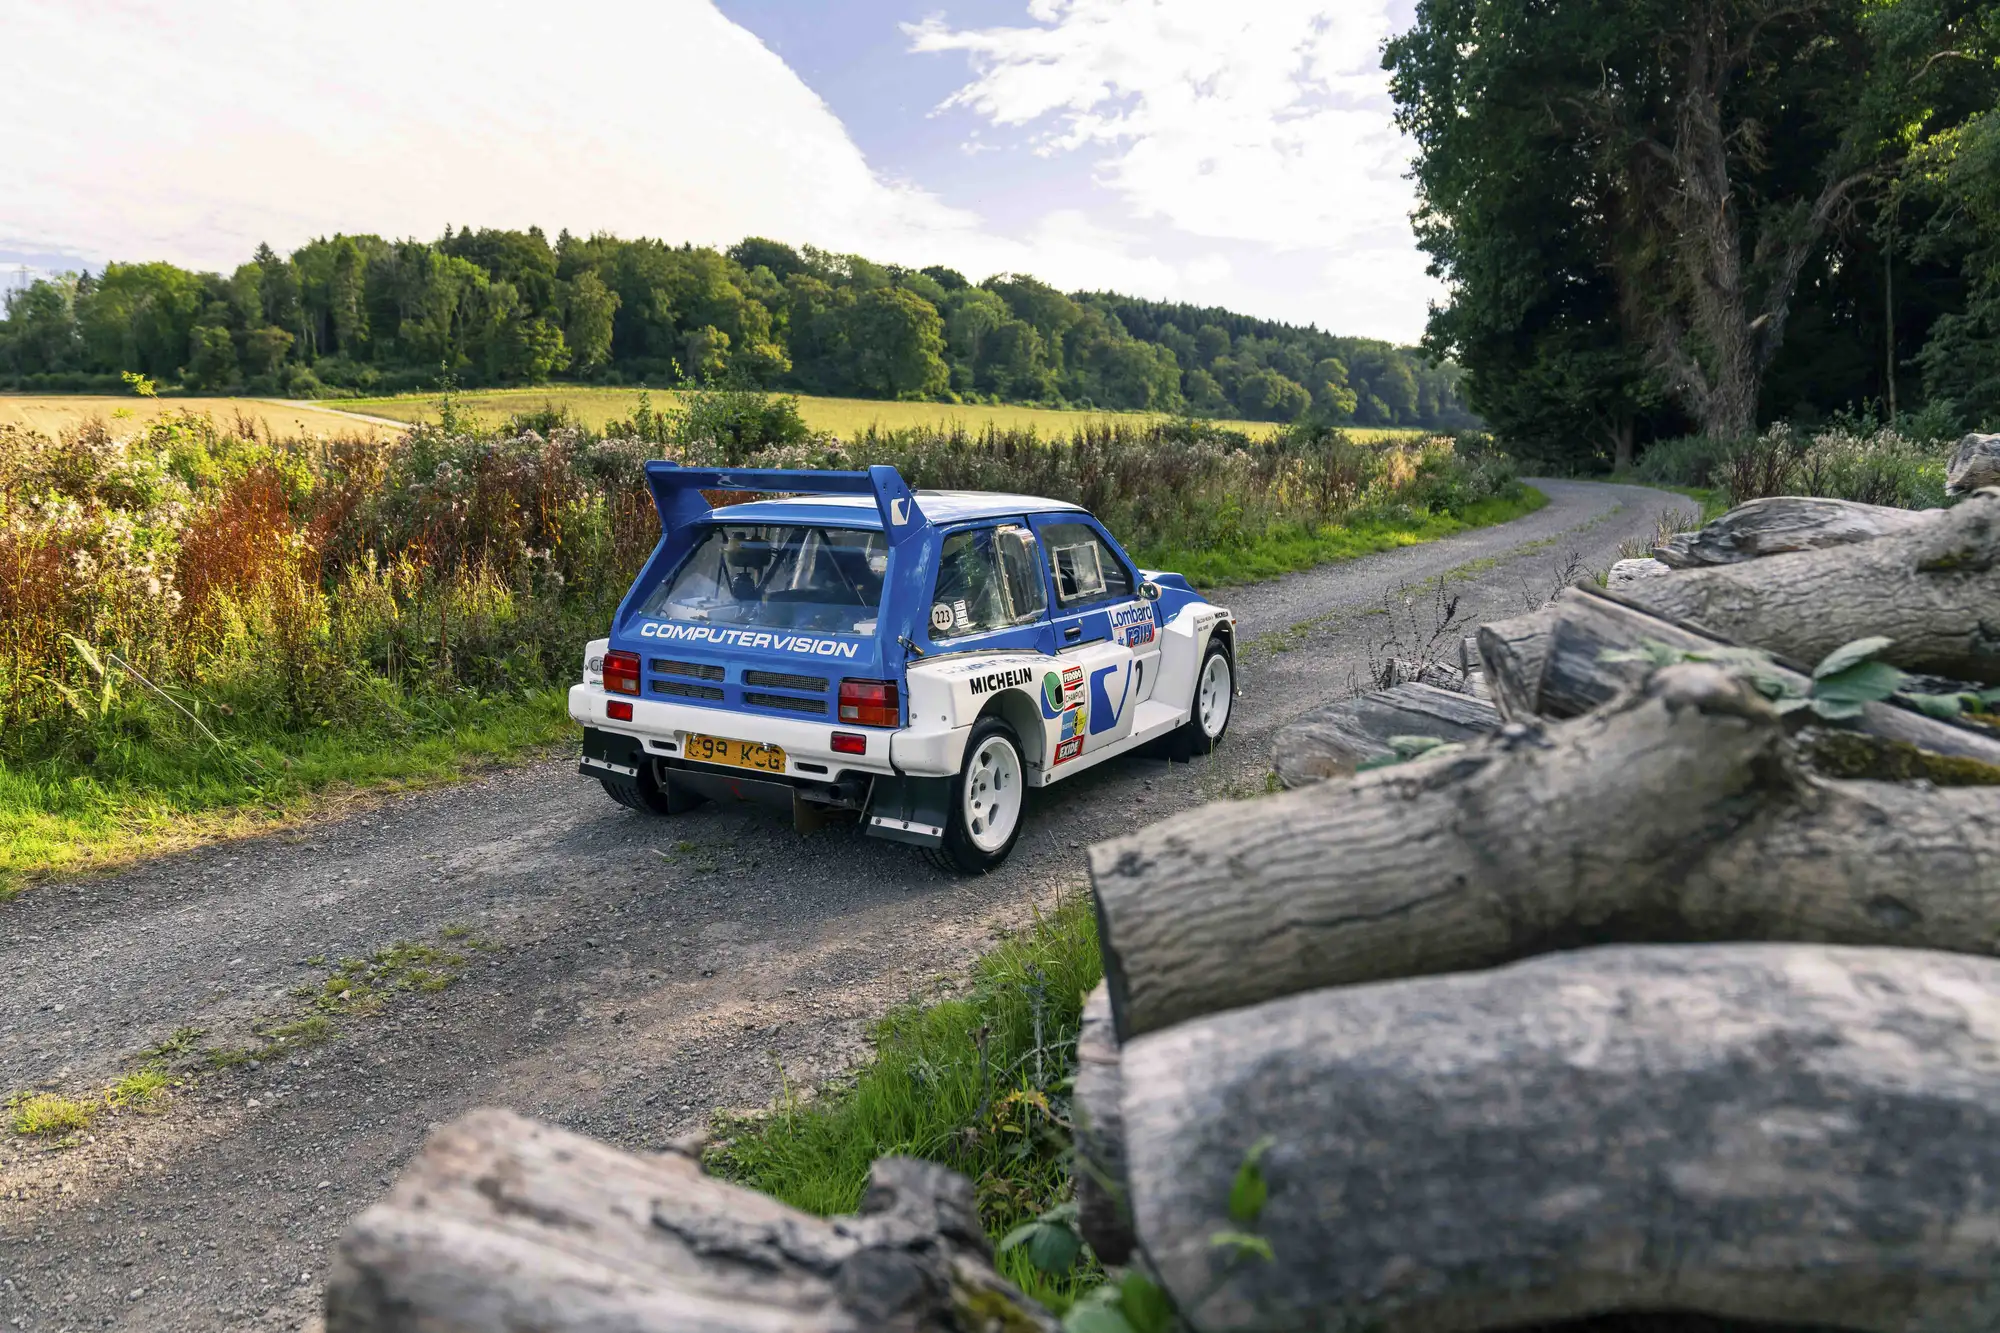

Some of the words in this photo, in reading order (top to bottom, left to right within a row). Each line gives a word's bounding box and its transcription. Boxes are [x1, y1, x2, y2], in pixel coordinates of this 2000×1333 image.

[935, 610, 951, 624] 223
[640, 622, 859, 658] COMPUTERVISION
[969, 667, 1032, 695] MICHELIN
[1058, 740, 1080, 759] EXIDE
